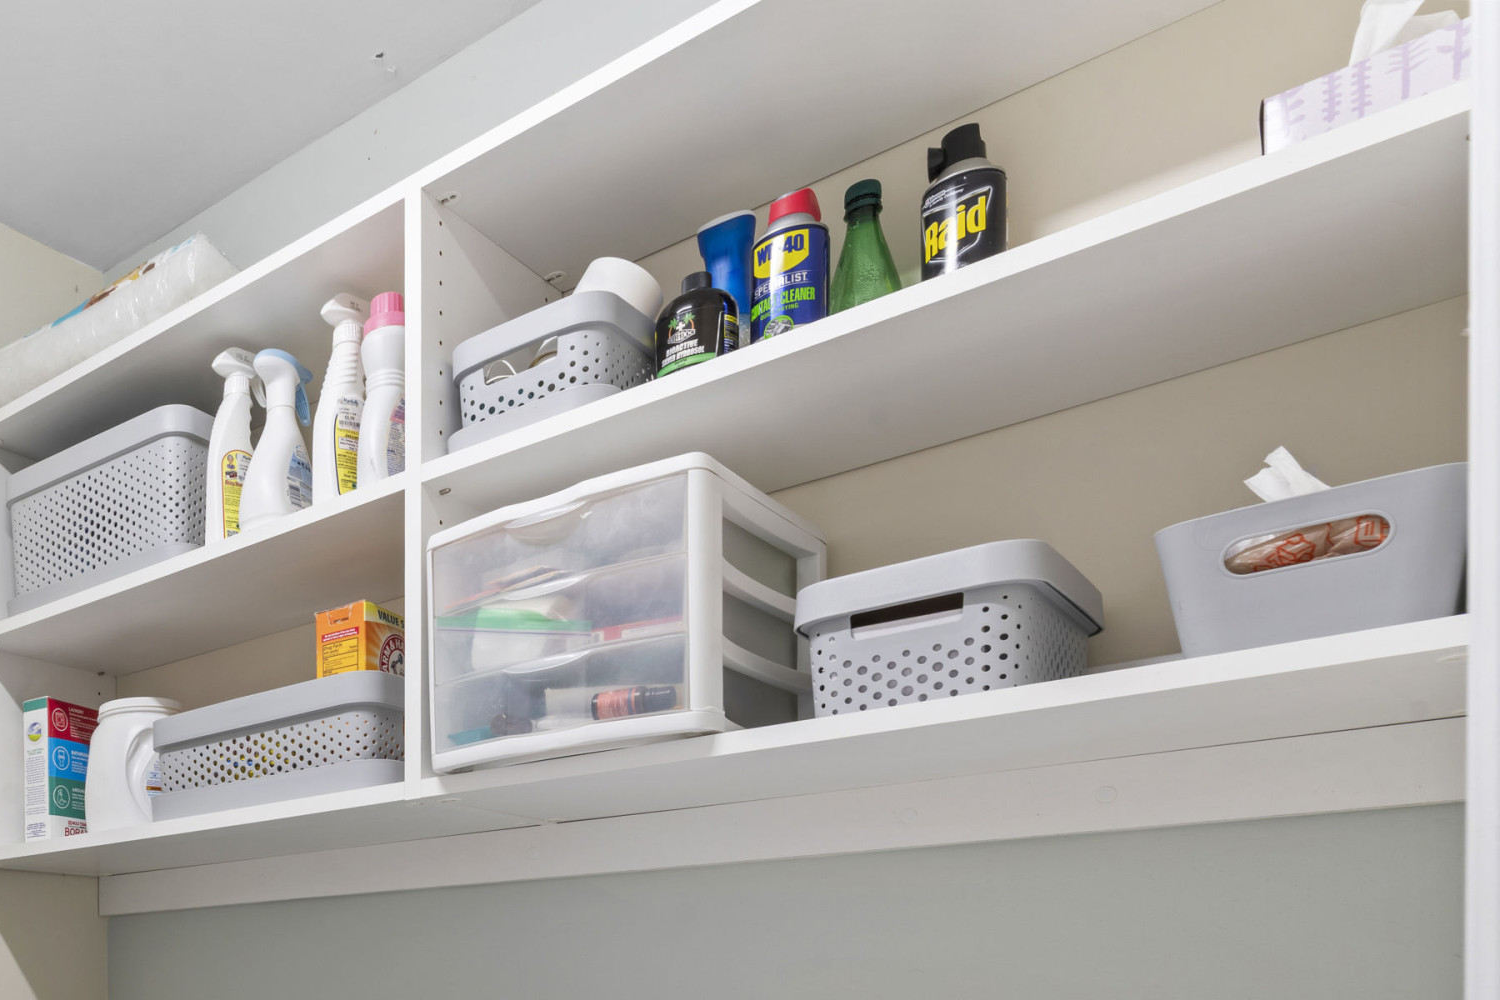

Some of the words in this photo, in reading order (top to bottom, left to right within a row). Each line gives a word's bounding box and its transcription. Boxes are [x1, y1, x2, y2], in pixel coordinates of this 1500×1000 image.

[925, 195, 986, 264] Raid
[757, 233, 804, 267] W40
[754, 272, 808, 300] SPEALIST
[780, 287, 815, 305] CLEANER
[378, 609, 400, 627] VALUE
